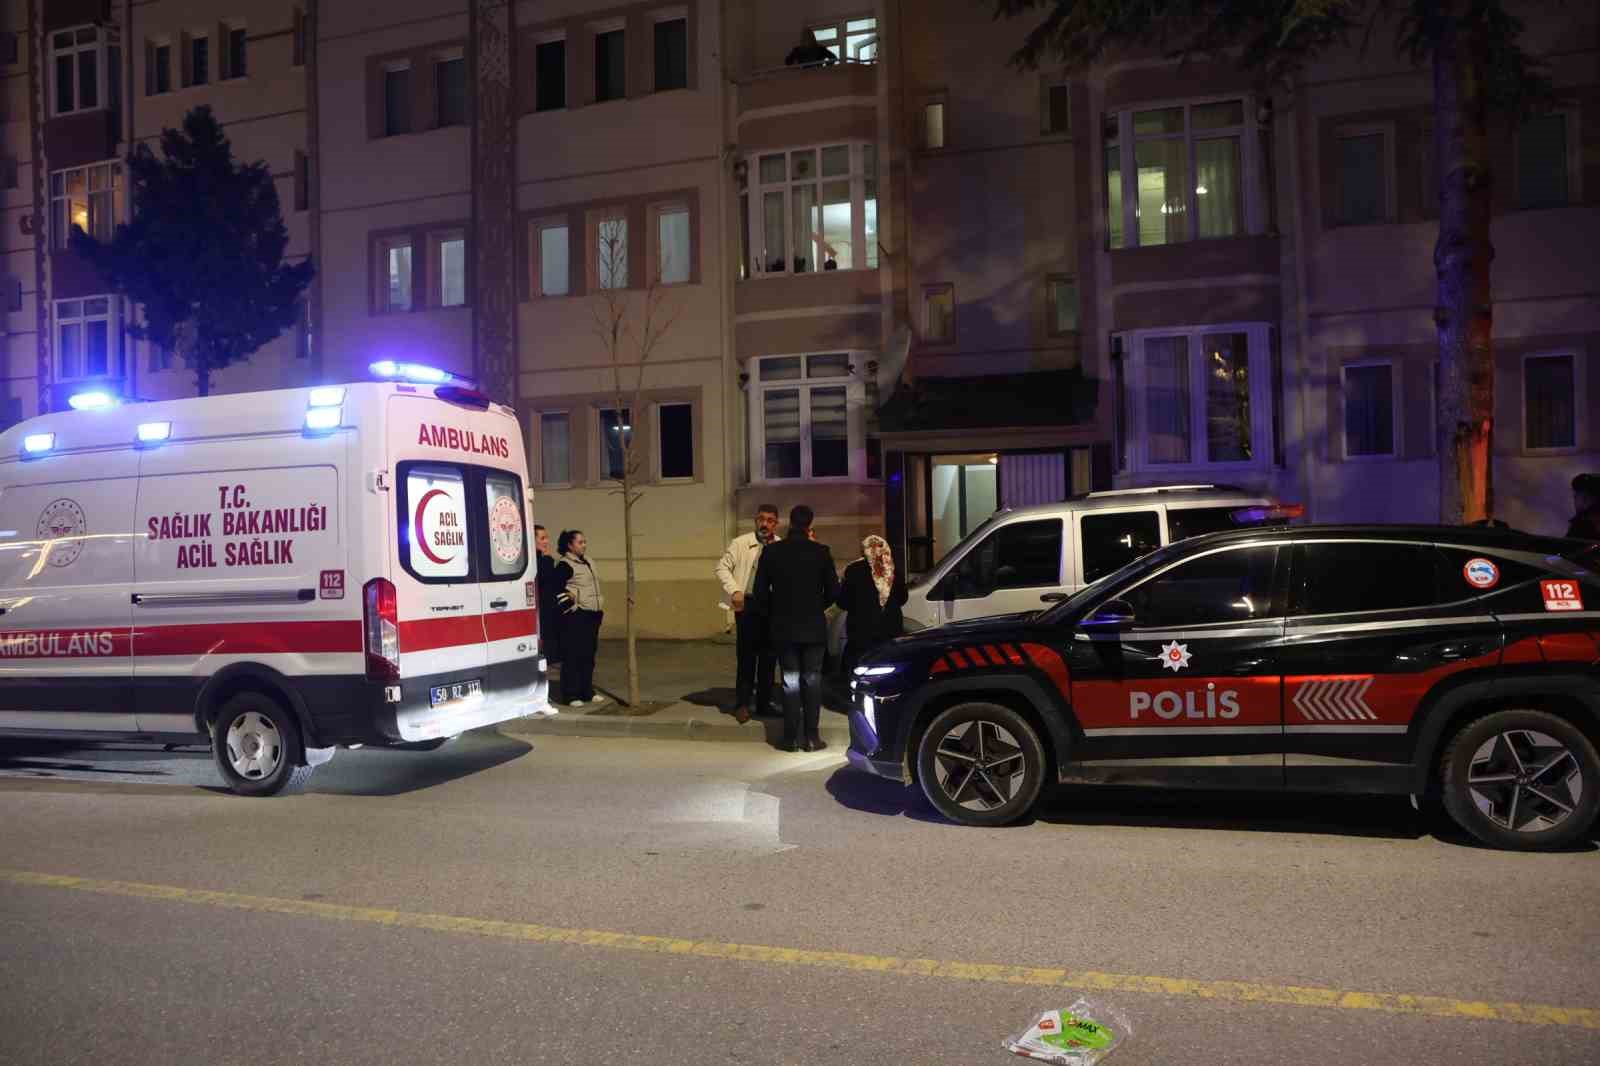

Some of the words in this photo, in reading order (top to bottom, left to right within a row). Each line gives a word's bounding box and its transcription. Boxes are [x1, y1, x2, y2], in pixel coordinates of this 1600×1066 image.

[418, 423, 509, 458] AMBULANS
[219, 484, 250, 509] T.C.
[148, 512, 212, 540] SAĞLIK
[223, 503, 327, 536] BAKANLIĞI
[440, 509, 458, 527] ACİL
[434, 528, 464, 546] SAĞLIK
[177, 540, 217, 568] ACİL
[225, 538, 293, 566] SAĞLIK
[323, 572, 341, 587] 112
[1546, 583, 1575, 599] 112
[1129, 682, 1240, 719] POLİS
